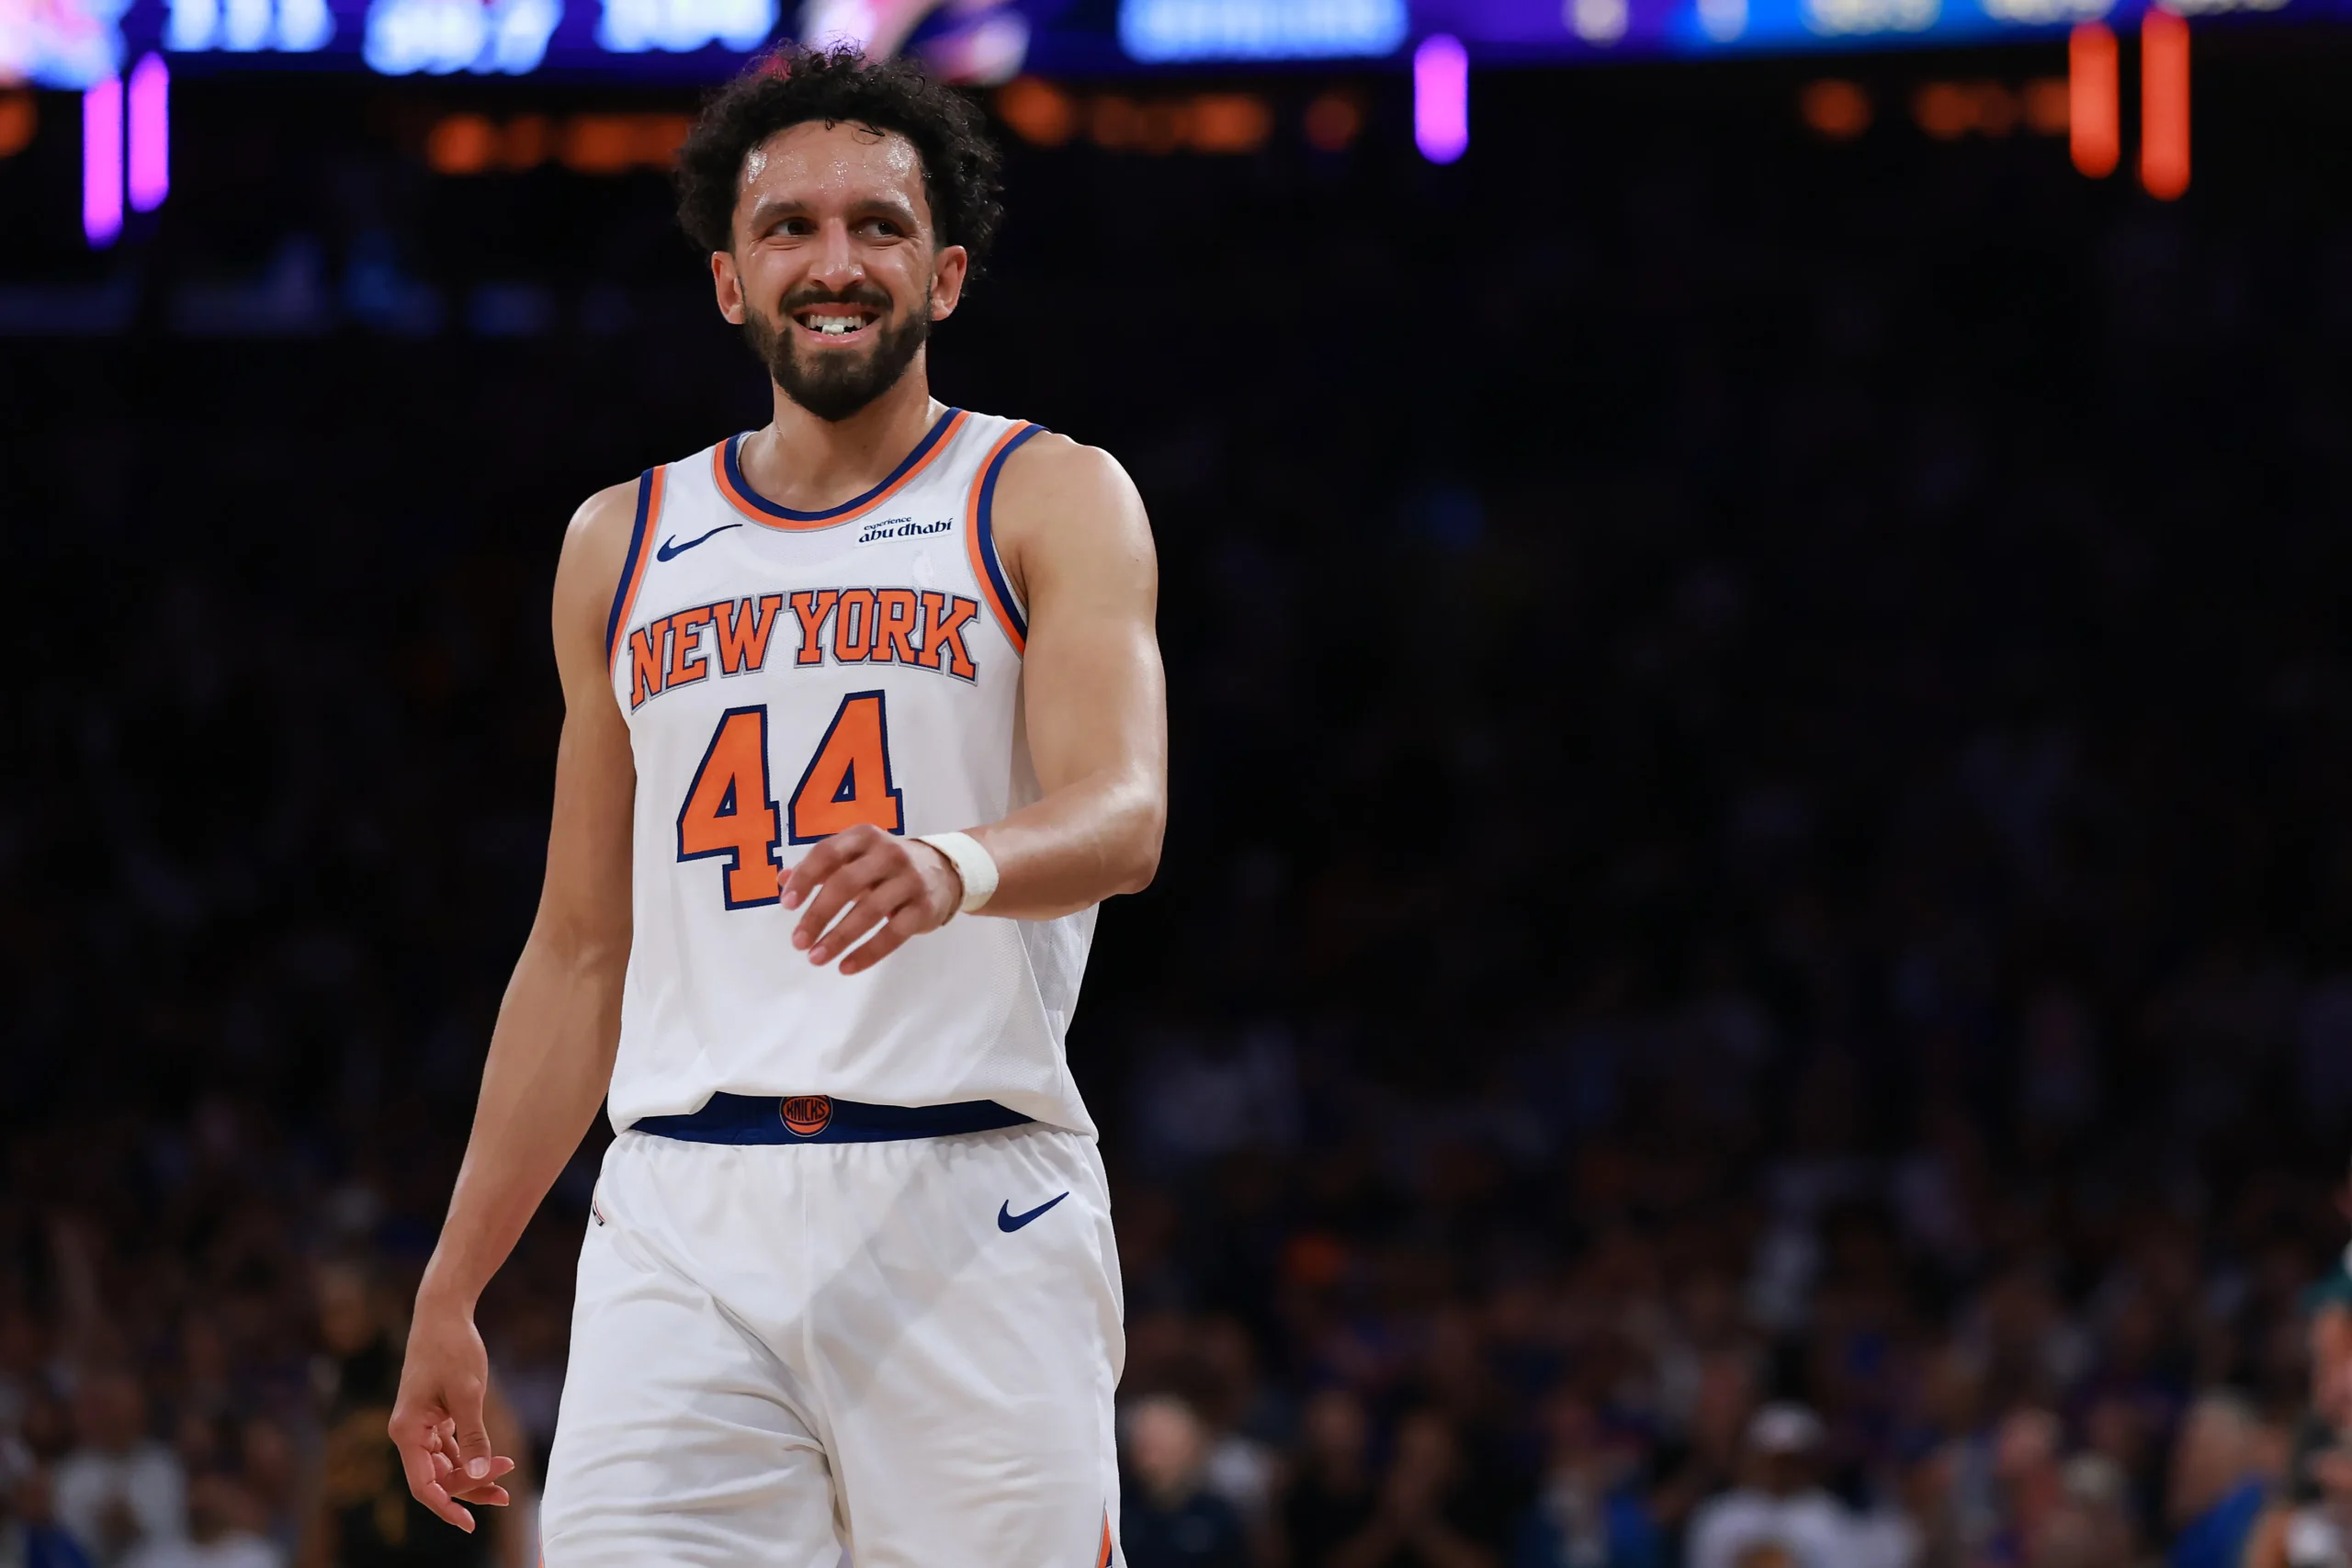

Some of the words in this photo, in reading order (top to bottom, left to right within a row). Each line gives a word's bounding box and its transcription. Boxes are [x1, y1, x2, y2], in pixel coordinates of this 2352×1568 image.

[859, 527, 894, 543] abu
[897, 517, 954, 536] dhabi
[864, 516, 911, 531] experience
[628, 590, 786, 715] NEW
[789, 585, 982, 687] YORK
[676, 689, 905, 911] 44
[786, 1098, 826, 1122] KNICKS
